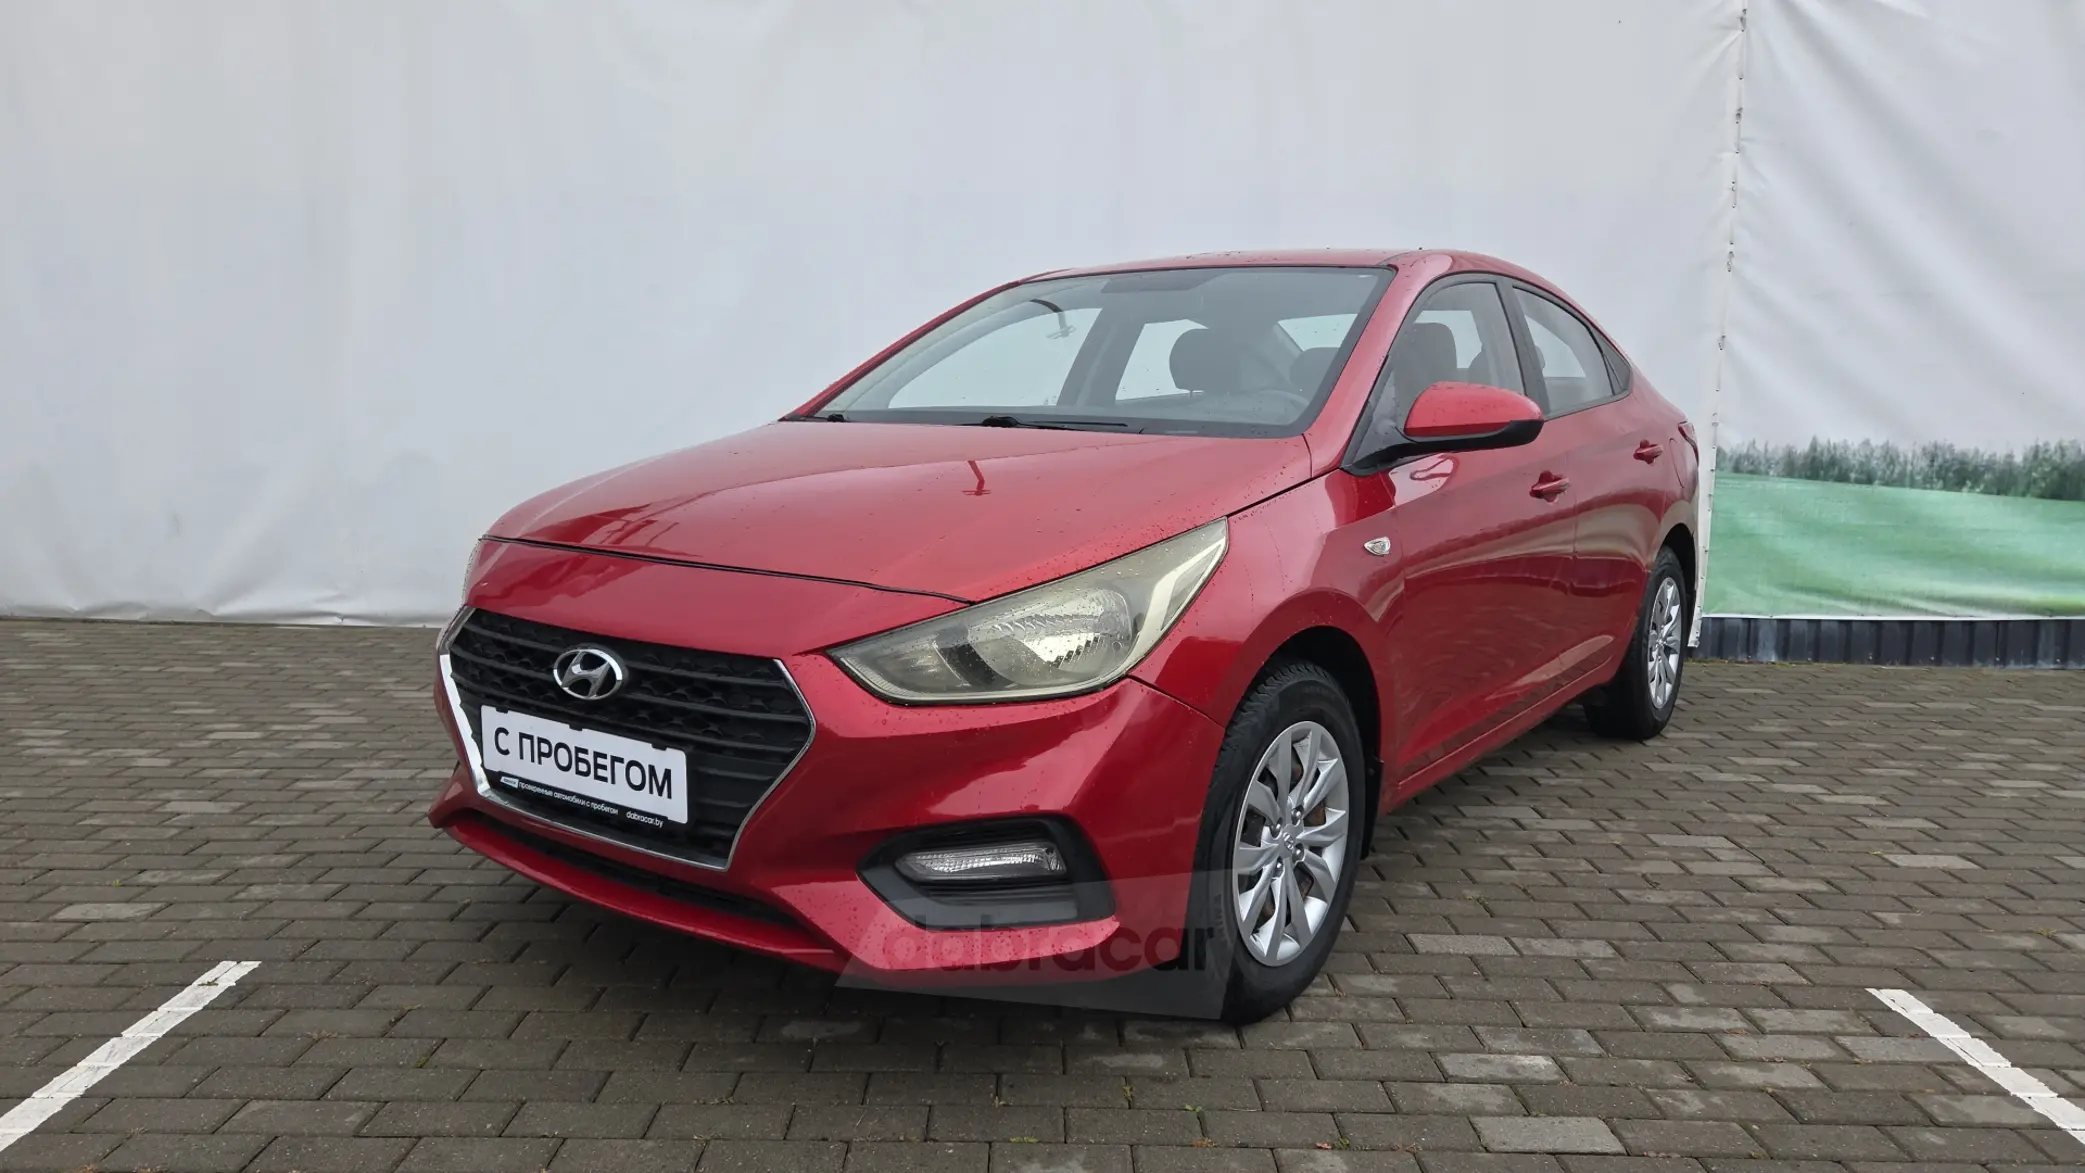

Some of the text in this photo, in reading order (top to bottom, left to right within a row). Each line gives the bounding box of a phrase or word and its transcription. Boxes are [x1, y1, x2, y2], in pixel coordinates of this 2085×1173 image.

[494, 727, 672, 799] С ПРОБЕГОМ
[554, 790, 585, 806] автомобили
[591, 801, 619, 815] пробегом
